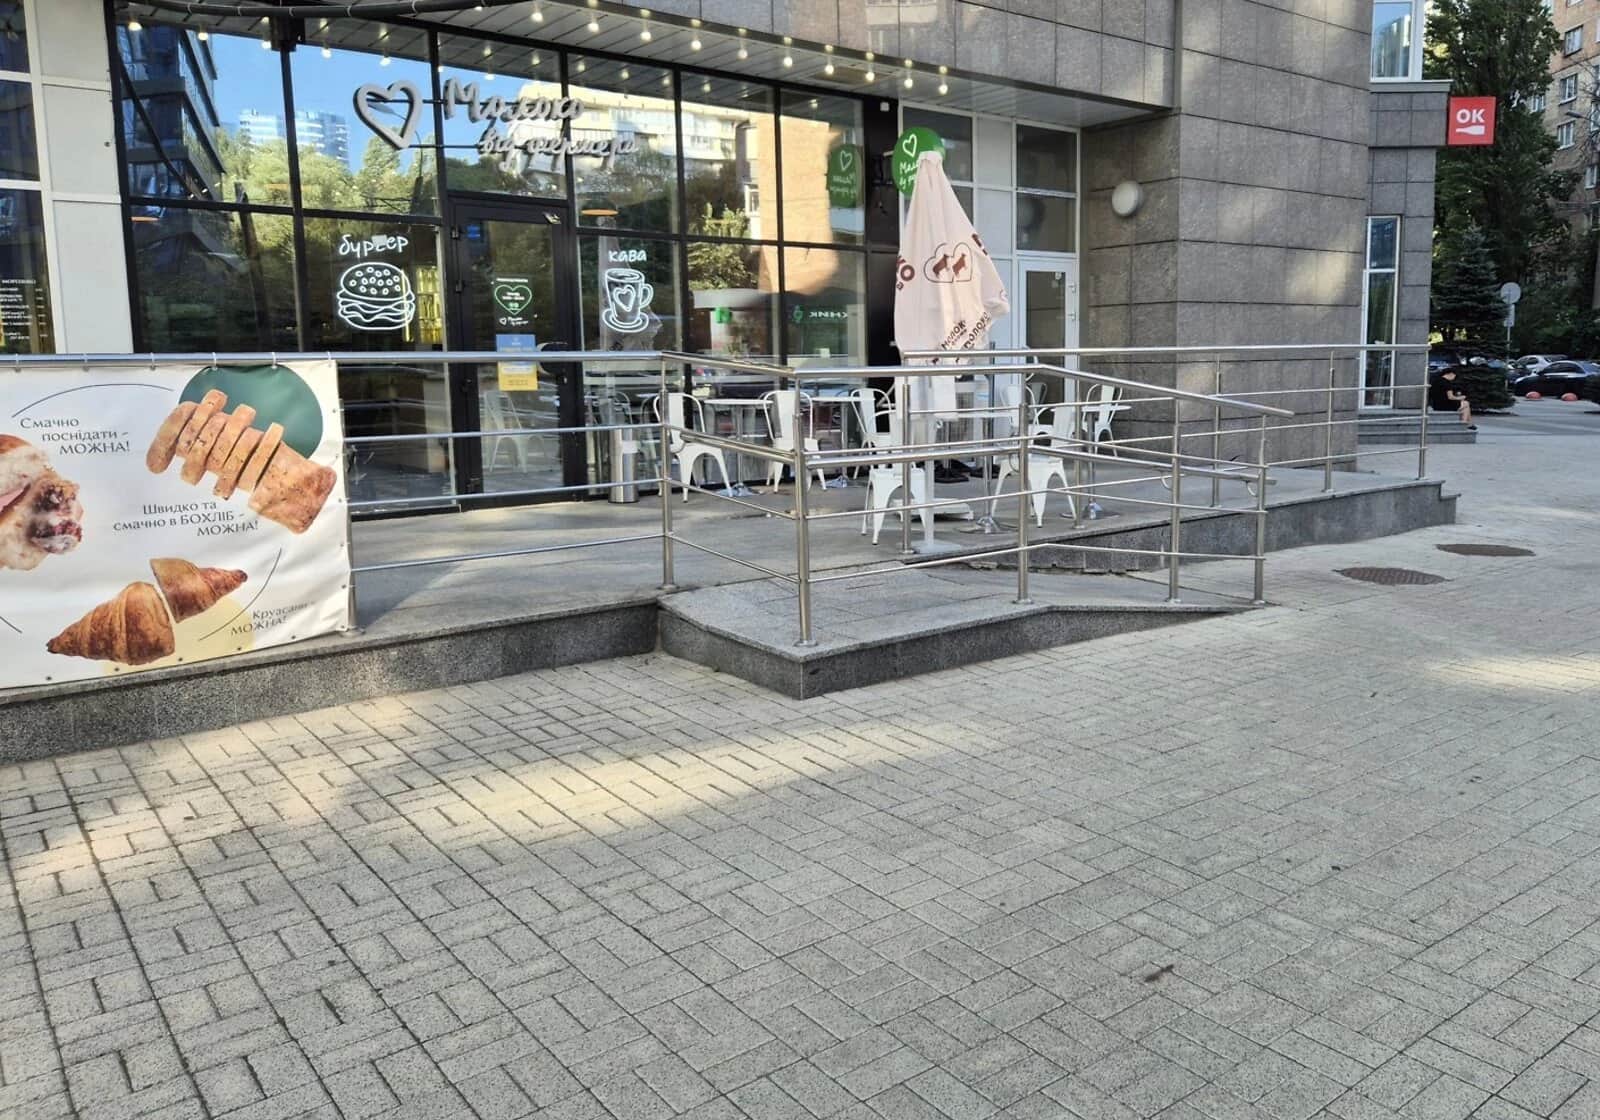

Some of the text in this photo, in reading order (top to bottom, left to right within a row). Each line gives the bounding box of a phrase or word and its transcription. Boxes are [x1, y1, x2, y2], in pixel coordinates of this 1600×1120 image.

[1456, 108, 1486, 124] OK
[20, 417, 79, 429] Смачно
[42, 430, 118, 442] поснідати
[59, 441, 131, 455] МОЖНА!
[143, 501, 217, 515] Швидко та
[113, 518, 166, 531] смачно
[169, 518, 177, 527] в
[197, 520, 259, 536] МОЖНА!
[231, 615, 287, 636] МОЖНА!
